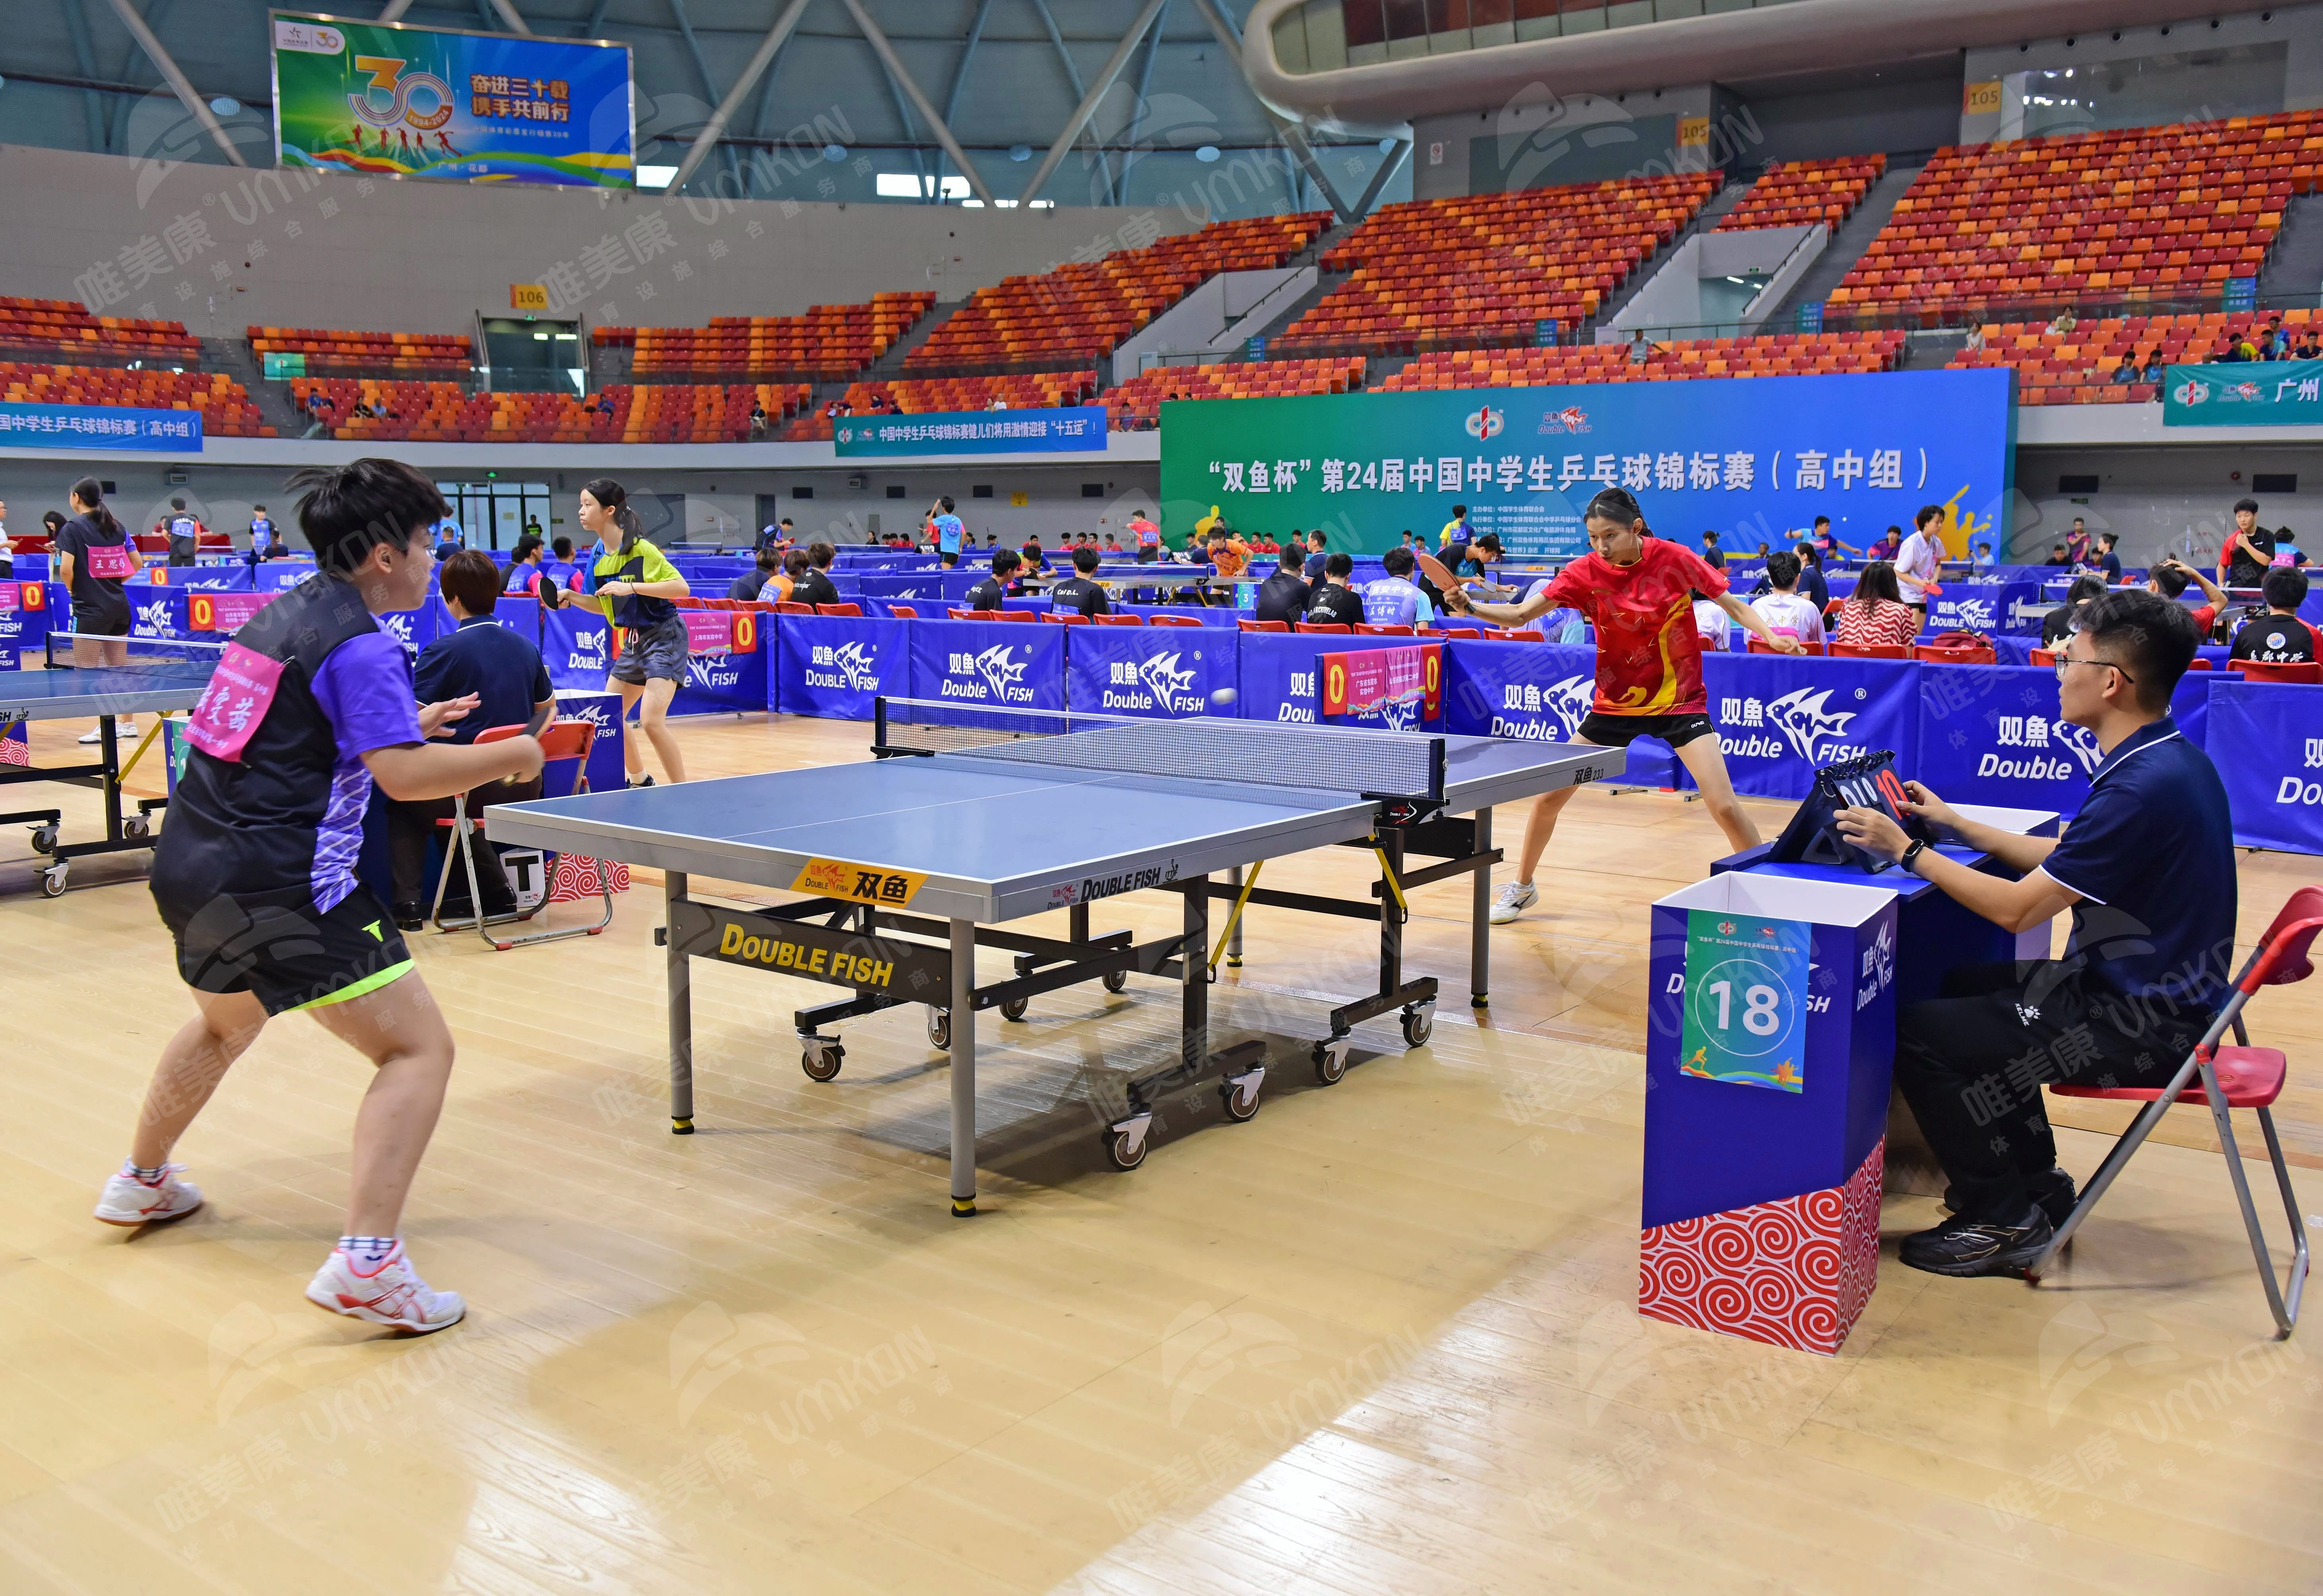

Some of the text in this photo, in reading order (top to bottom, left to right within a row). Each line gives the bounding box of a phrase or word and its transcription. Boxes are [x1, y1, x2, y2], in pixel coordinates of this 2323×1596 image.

[1970, 90, 1999, 107] 105
[409, 104, 451, 128] 1994-2024
[1682, 125, 1708, 140] 105
[517, 290, 545, 304] 106
[2275, 378, 2320, 403] 广州
[1538, 425, 1565, 434] Double
[155, 569, 165, 585] 0
[26, 586, 40, 606] 0
[1243, 593, 1248, 602] 3
[1372, 585, 1413, 595] 西安中学
[195, 600, 211, 624] 0
[1975, 619, 1997, 628] FISH
[134, 624, 157, 636] Double
[737, 617, 752, 646] 0
[812, 646, 833, 666] 双魚
[949, 652, 975, 675] 双魚
[712, 672, 738, 686] FISH
[857, 676, 878, 691] FISH
[1110, 662, 1138, 685] 双魚
[1330, 664, 1344, 704] 0
[1427, 655, 1438, 692] 0
[941, 679, 1034, 702] Double FISH
[1103, 690, 1204, 712] Double FISH
[1503, 684, 1542, 712] 双魚
[1720, 697, 1764, 727] 双魚
[597, 728, 616, 738] FISH
[1490, 716, 1558, 741] Double
[1996, 715, 2050, 748] 双魚
[1714, 732, 1867, 763] ouble FISH
[1573, 765, 1604, 785] 双鱼 233
[1977, 753, 2072, 781] Double
[505, 855, 539, 892] T
[1134, 867, 1161, 889] FISH
[836, 883, 848, 893] FISH
[852, 871, 908, 904] 双鱼
[830, 952, 894, 987] FISH
[1883, 964, 1893, 987] FISH
[1857, 979, 1877, 1012] Double
[1709, 980, 1780, 1036] 18
[2014, 1003, 2030, 1027] KELME
